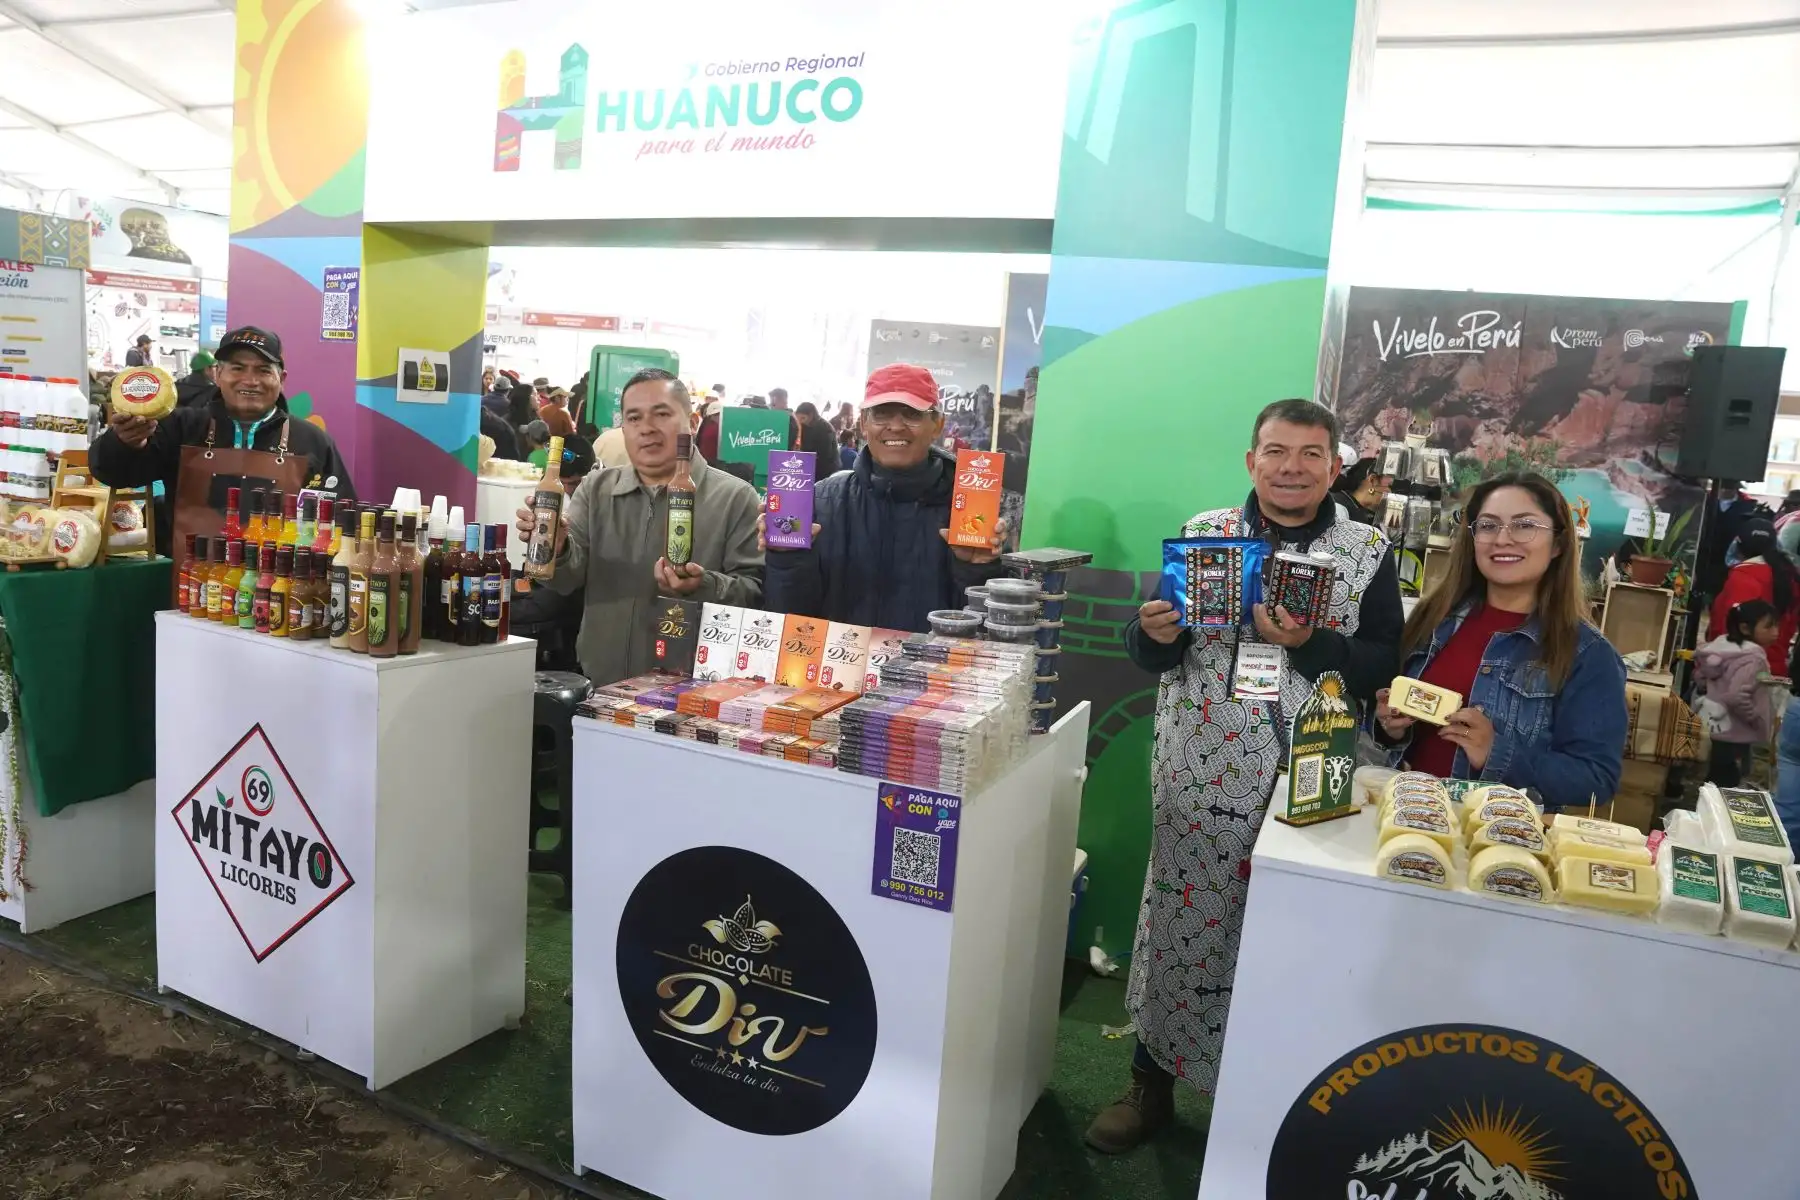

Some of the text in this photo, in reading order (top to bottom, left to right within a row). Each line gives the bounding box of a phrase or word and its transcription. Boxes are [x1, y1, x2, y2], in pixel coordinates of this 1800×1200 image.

[705, 52, 866, 77] Gobierno Regional
[596, 70, 864, 133] HUÁNUCO
[635, 128, 817, 161] para el mundo
[326, 271, 358, 281] PAGA AQUI
[326, 281, 339, 289] CON
[1447, 336, 1465, 347] en
[1457, 310, 1522, 350] Perú
[1562, 328, 1598, 340] prom
[1572, 335, 1603, 348] perú
[937, 384, 975, 412] Perú
[758, 429, 781, 444] Perú
[772, 473, 811, 489] Div
[958, 472, 998, 489] Div
[957, 533, 986, 545] NARANJA
[659, 620, 688, 637] Div
[703, 627, 737, 643] Div
[743, 632, 778, 649] Div
[785, 639, 821, 656] Div
[827, 646, 864, 663] Div
[247, 778, 270, 803] 69
[908, 793, 959, 808] PAGA AQUI
[908, 803, 957, 832] CON yape
[191, 797, 334, 889] MITAYO
[220, 860, 297, 905] LICORES
[1676, 872, 1715, 885] Fresco
[889, 880, 945, 901] 990 756 012
[1741, 885, 1782, 898] Fresco
[687, 943, 793, 986] CHOCOLATE
[656, 972, 829, 1062] Div
[690, 1053, 741, 1080] Endulza
[743, 1074, 757, 1085] tu
[1307, 1031, 1688, 1200] PRODUCTOS LÁCTEOS
